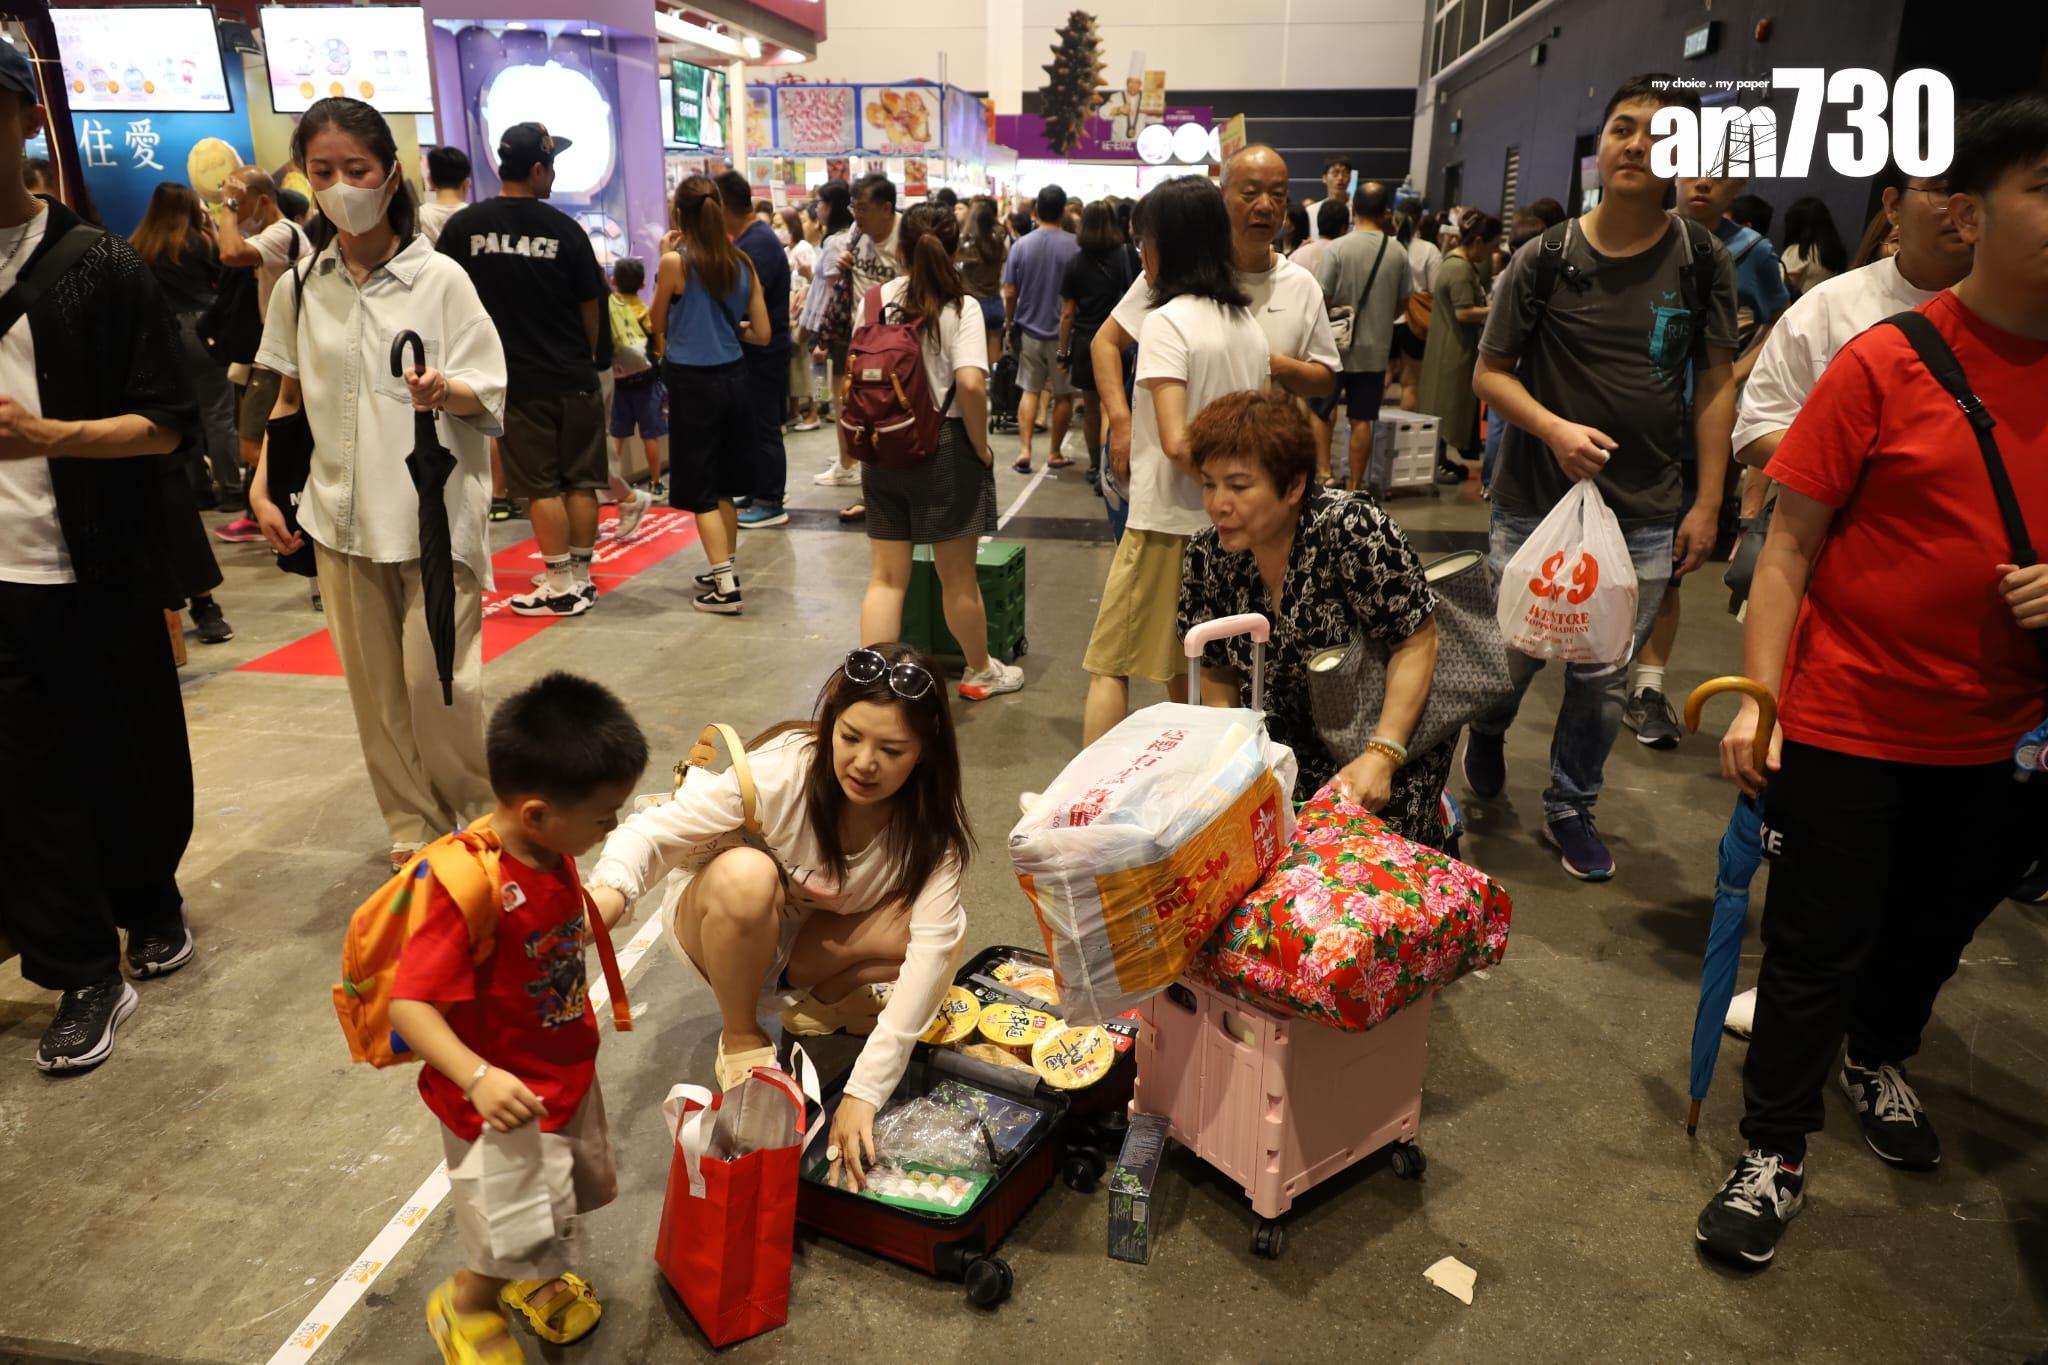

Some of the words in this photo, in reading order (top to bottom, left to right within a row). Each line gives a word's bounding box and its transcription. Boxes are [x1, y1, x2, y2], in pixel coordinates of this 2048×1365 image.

[41, 118, 164, 171] 住愛
[470, 232, 559, 259] PALACE
[1759, 821, 1784, 856] KE
